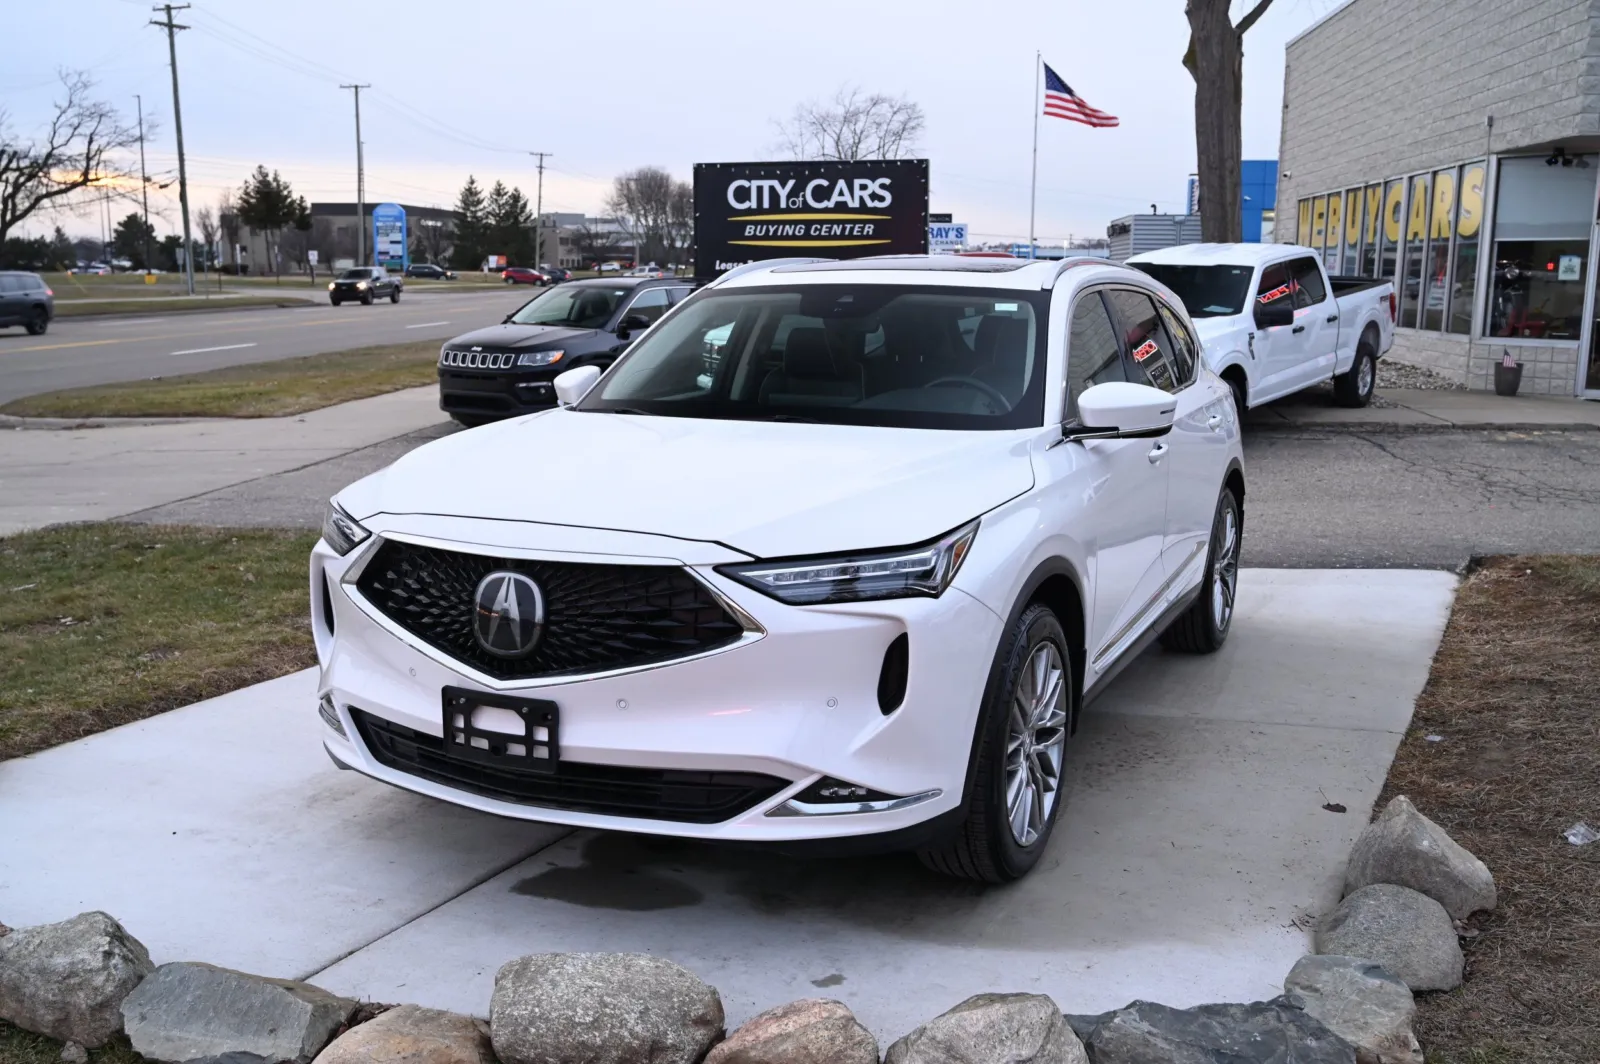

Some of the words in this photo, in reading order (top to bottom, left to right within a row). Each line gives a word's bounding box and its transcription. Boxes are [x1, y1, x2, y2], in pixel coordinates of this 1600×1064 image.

[727, 179, 796, 209] CITY
[788, 192, 805, 209] of
[804, 177, 892, 209] CARS
[1326, 186, 1382, 247] BUY
[1384, 167, 1485, 243] CARS
[744, 224, 806, 236] BUYING
[810, 224, 875, 236] CENTER
